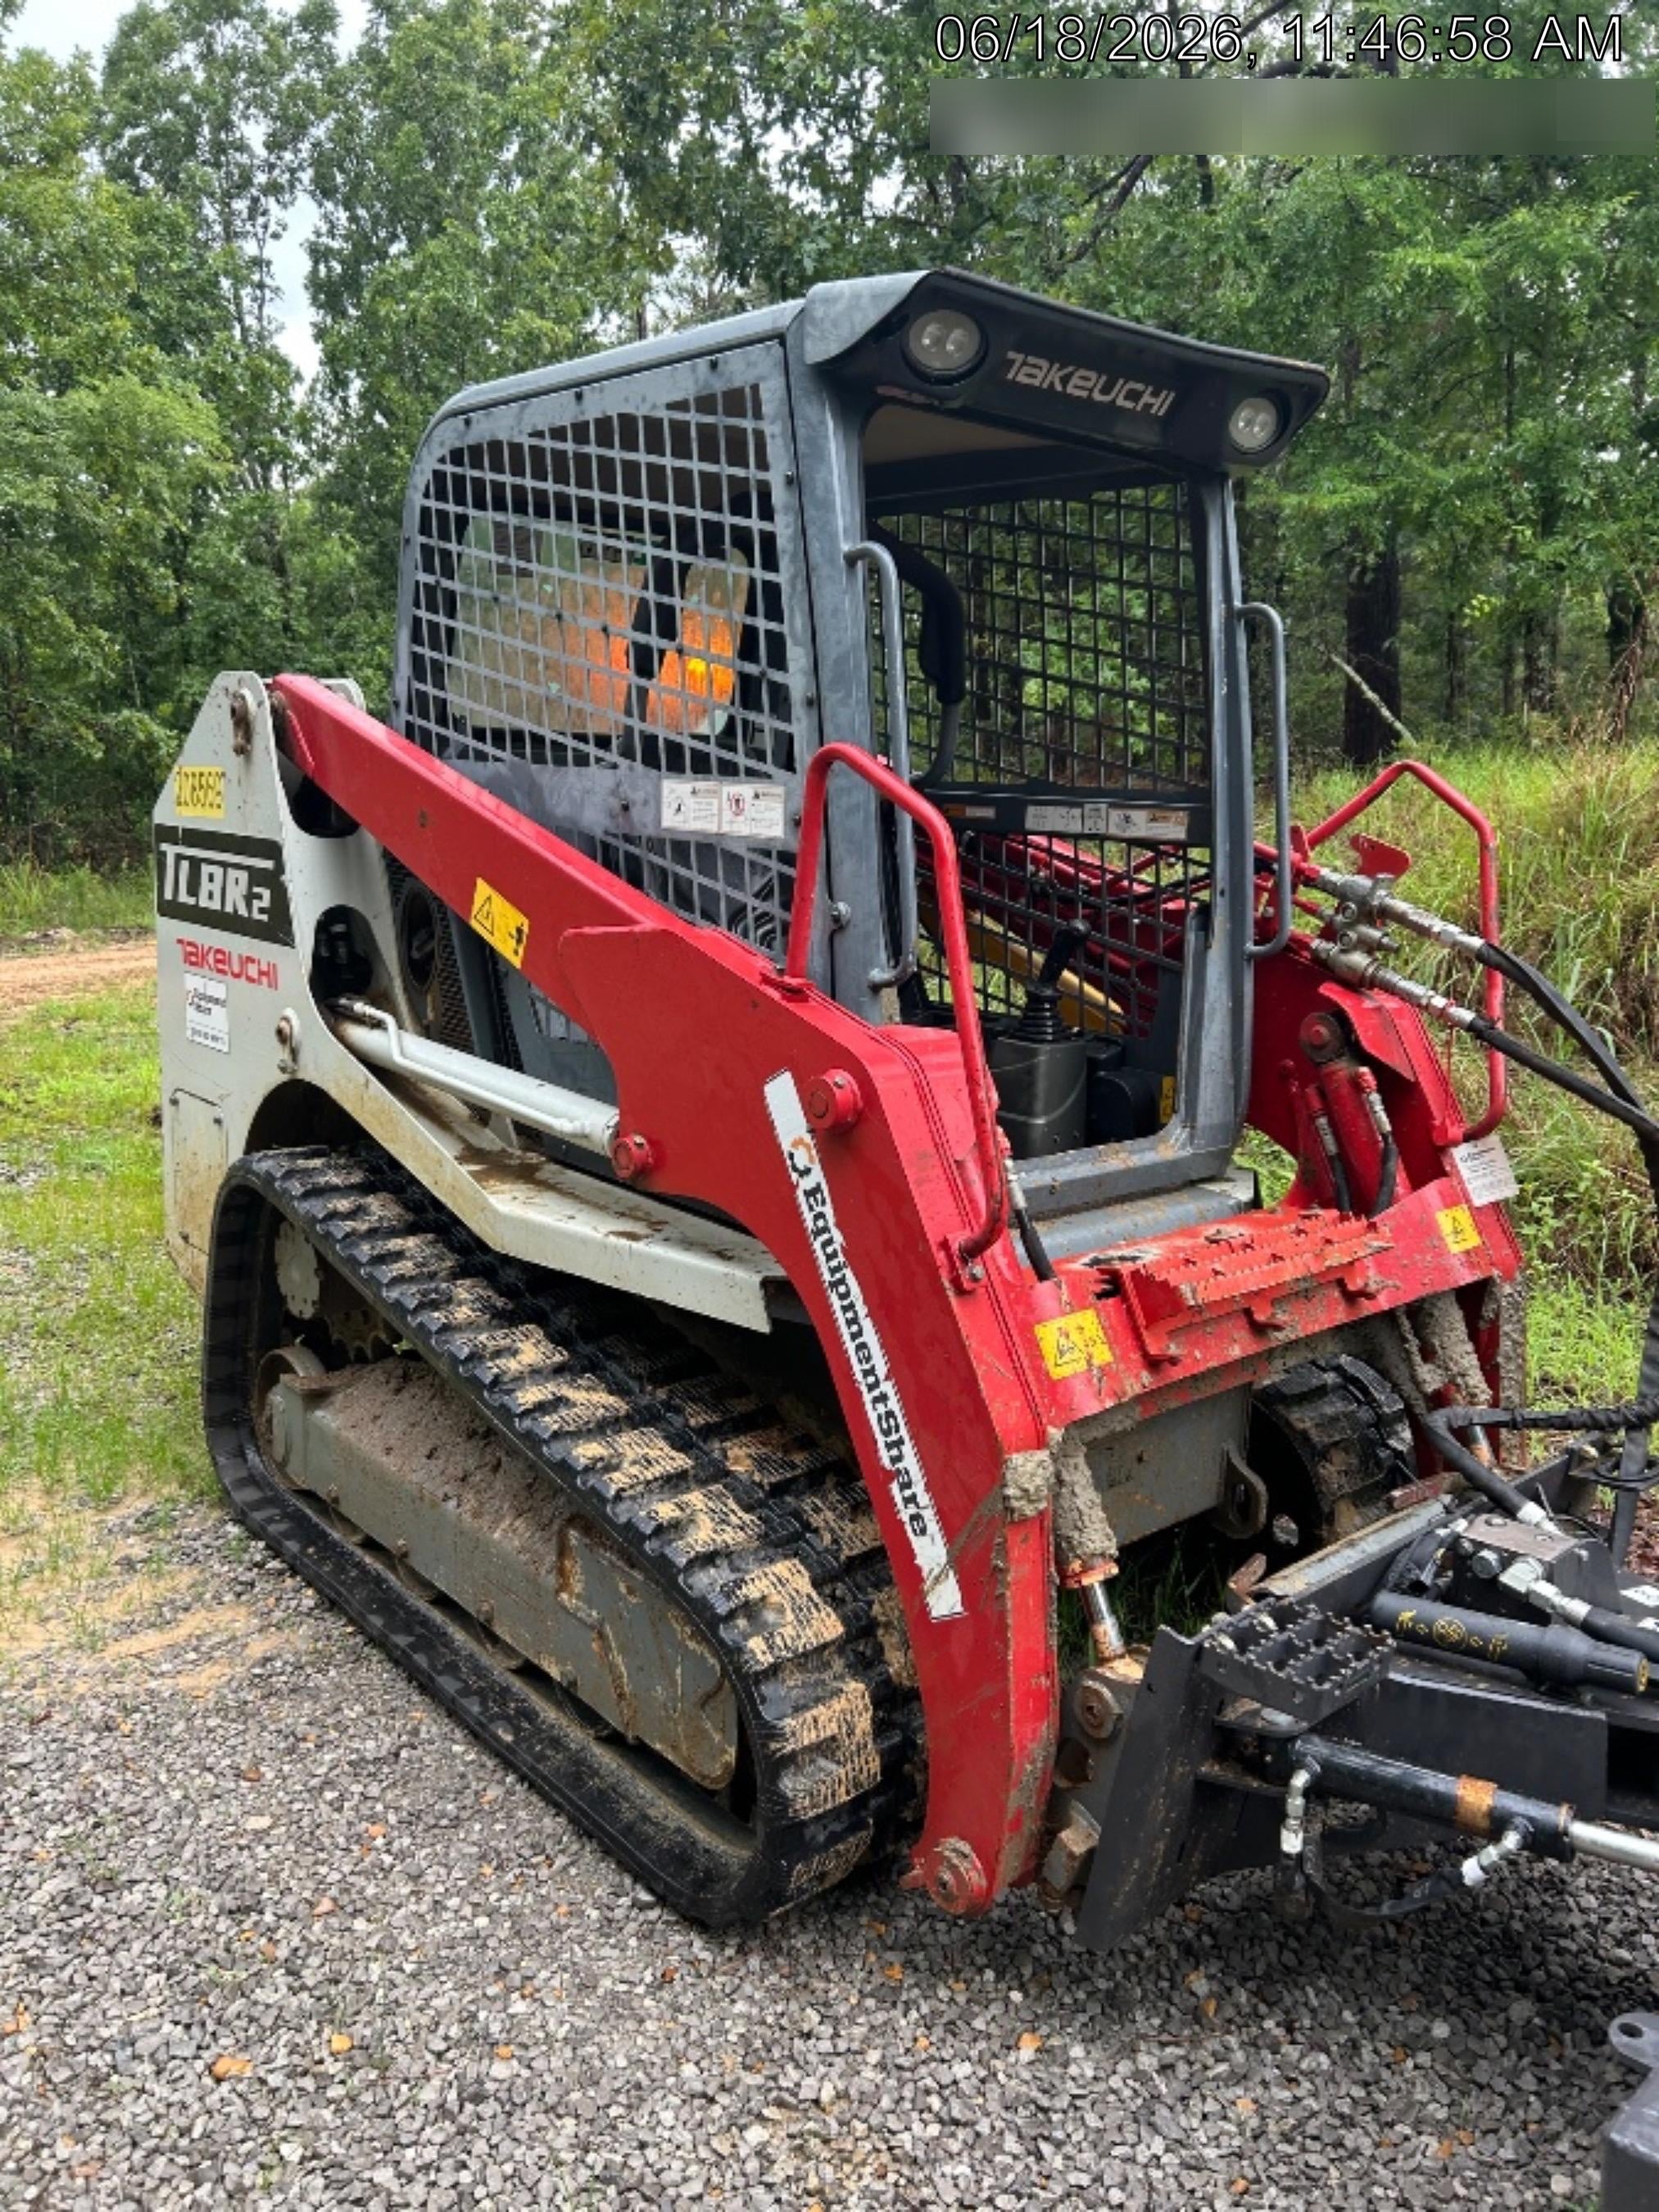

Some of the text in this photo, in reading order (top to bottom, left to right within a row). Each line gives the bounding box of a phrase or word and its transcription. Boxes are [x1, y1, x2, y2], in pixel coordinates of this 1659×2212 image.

[1004, 351, 1176, 416] TAKEUCHI
[159, 841, 274, 922] TL8R2
[176, 937, 279, 990] TAKEUCHI
[803, 1182, 928, 1537] EquipmentShare
